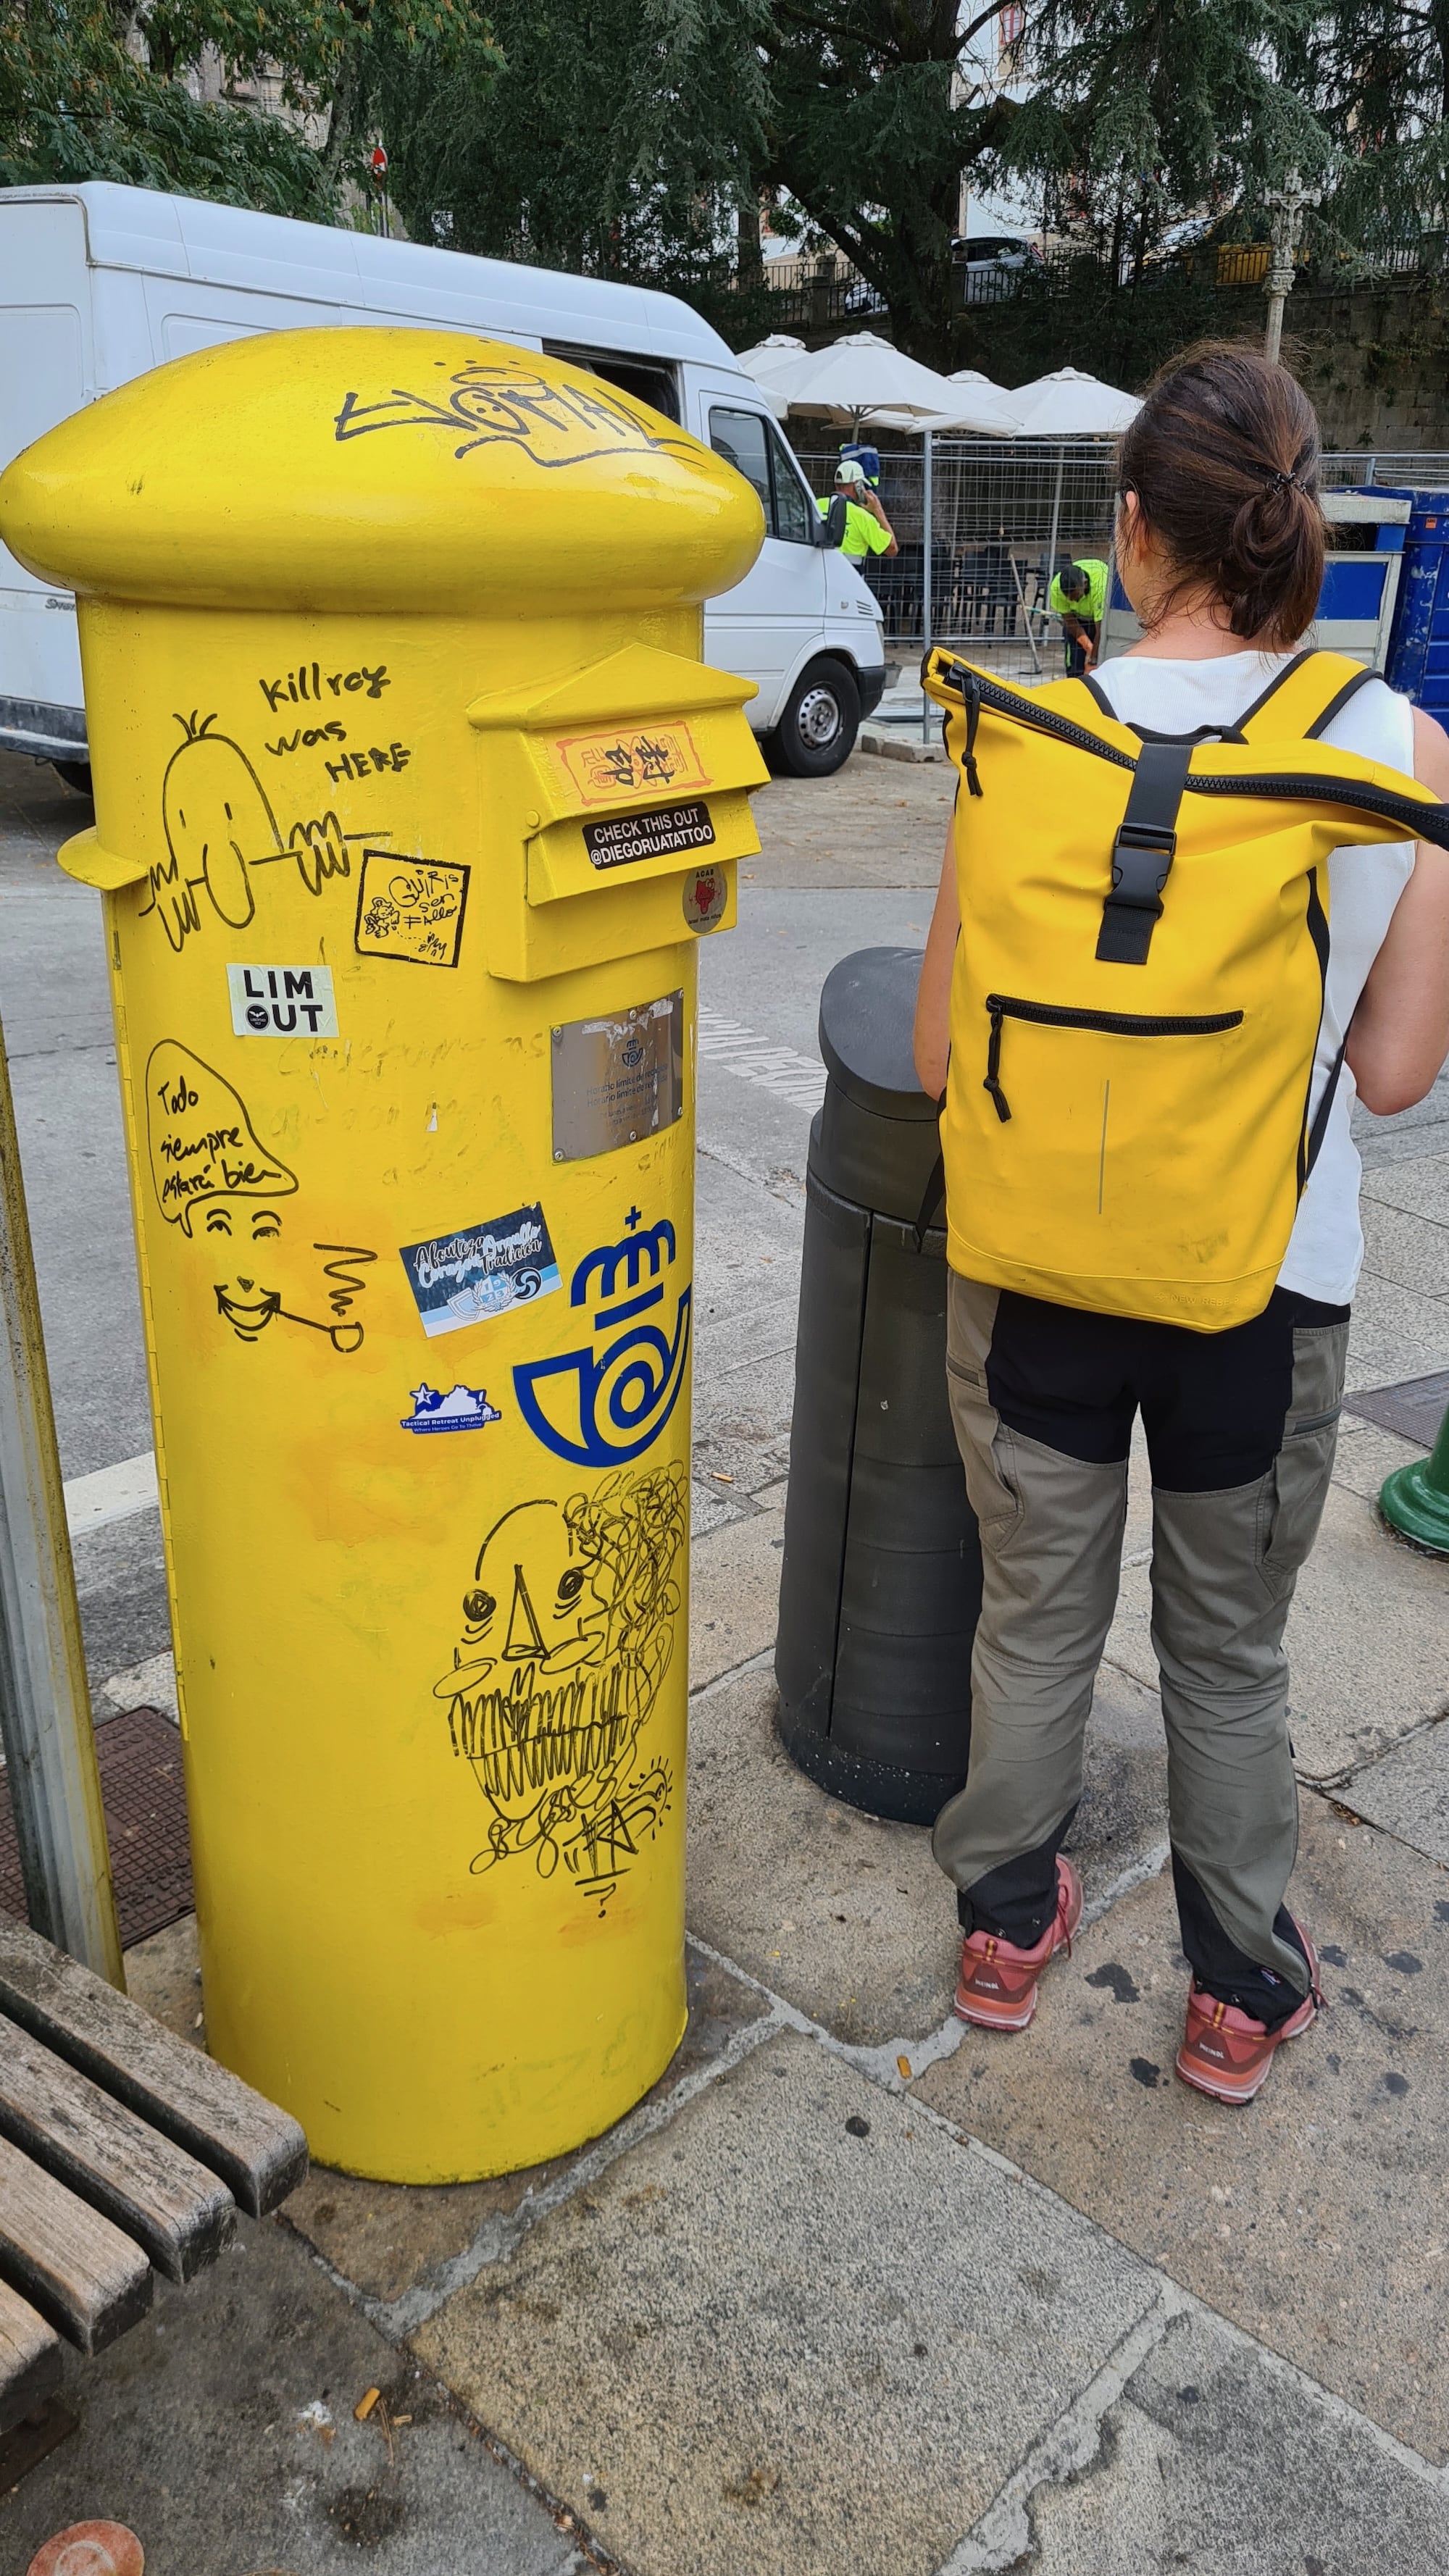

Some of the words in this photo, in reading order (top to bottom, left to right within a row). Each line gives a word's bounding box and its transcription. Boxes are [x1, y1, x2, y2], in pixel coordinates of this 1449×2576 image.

[264, 721, 346, 756] was
[325, 742, 411, 782] HERE
[593, 820, 642, 844] CHECK
[642, 814, 673, 835] THIS
[674, 808, 699, 827] OUT
[590, 825, 713, 865] @DIEGORUATATTOO
[696, 869, 714, 879] ACAB
[243, 970, 314, 999] LIM
[157, 1075, 199, 1116] Todo
[161, 1126, 243, 1163] siempre
[221, 1159, 282, 1189] bien
[1171, 1294, 1196, 1304] NEW
[1202, 1295, 1240, 1306] REBES
[431, 1416, 459, 1426] Retreat
[460, 1412, 500, 1423] Unplugged
